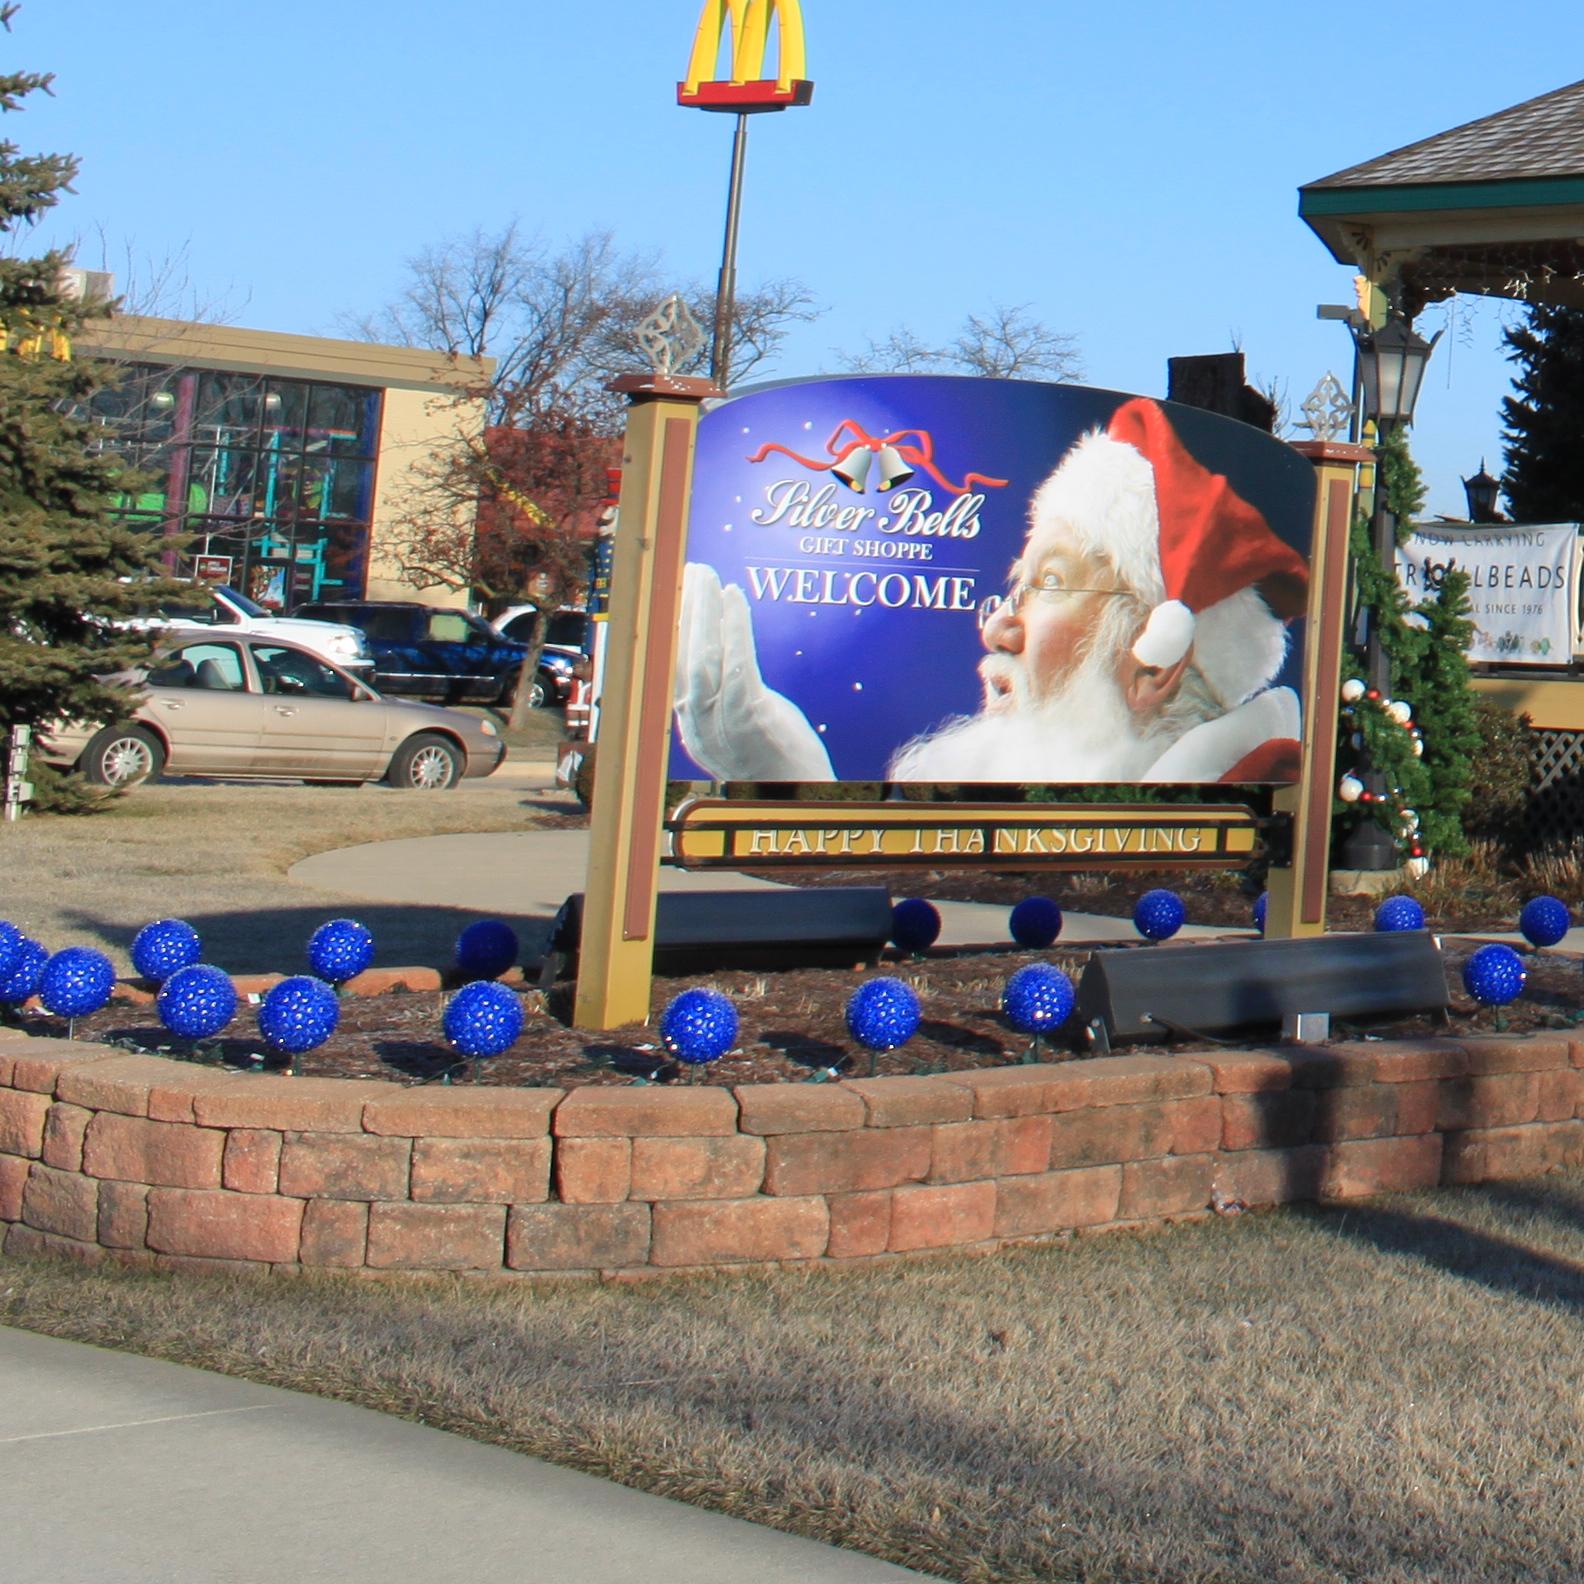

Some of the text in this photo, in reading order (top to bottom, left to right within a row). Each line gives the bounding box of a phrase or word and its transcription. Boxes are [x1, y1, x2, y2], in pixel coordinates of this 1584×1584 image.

[751, 479, 986, 540] Silver Bells
[799, 535, 933, 561] GIFT SHOPPE
[1414, 531, 1546, 548] NOW CARRYING
[745, 566, 977, 611] WELCOME
[1485, 603, 1517, 615] SINCE
[1521, 604, 1544, 616] 1976
